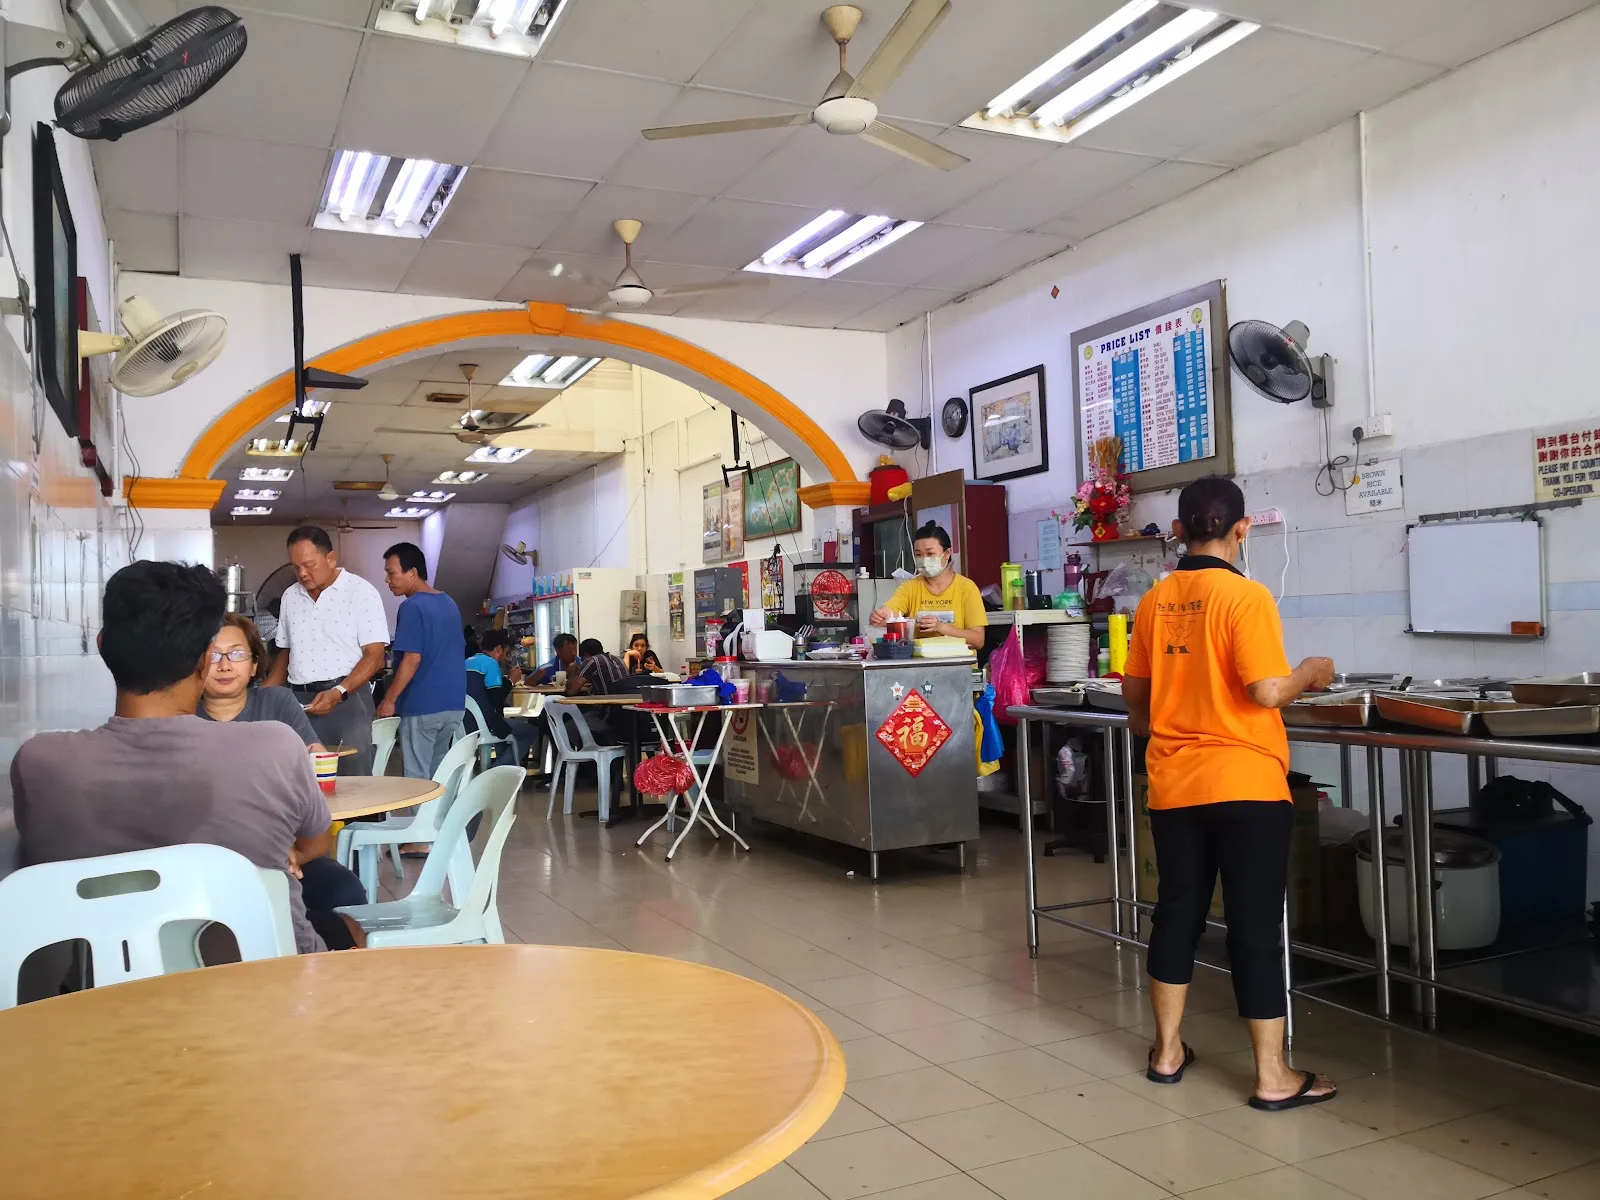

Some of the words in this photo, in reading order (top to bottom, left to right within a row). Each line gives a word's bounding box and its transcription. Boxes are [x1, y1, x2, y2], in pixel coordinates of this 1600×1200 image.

[1101, 336, 1126, 354] PRICE
[1129, 328, 1151, 344] LIST
[1538, 464, 1558, 474] PLEASE
[1560, 462, 1569, 472] PAY
[1572, 461, 1578, 470] AT
[1361, 470, 1385, 479] BROWN
[1542, 476, 1560, 487] THANK
[1562, 474, 1573, 484] YOU
[1574, 472, 1586, 482] FOR
[1366, 480, 1382, 488] RICE
[1359, 487, 1393, 498] AVAILABLE
[895, 715, 929, 749] 福
